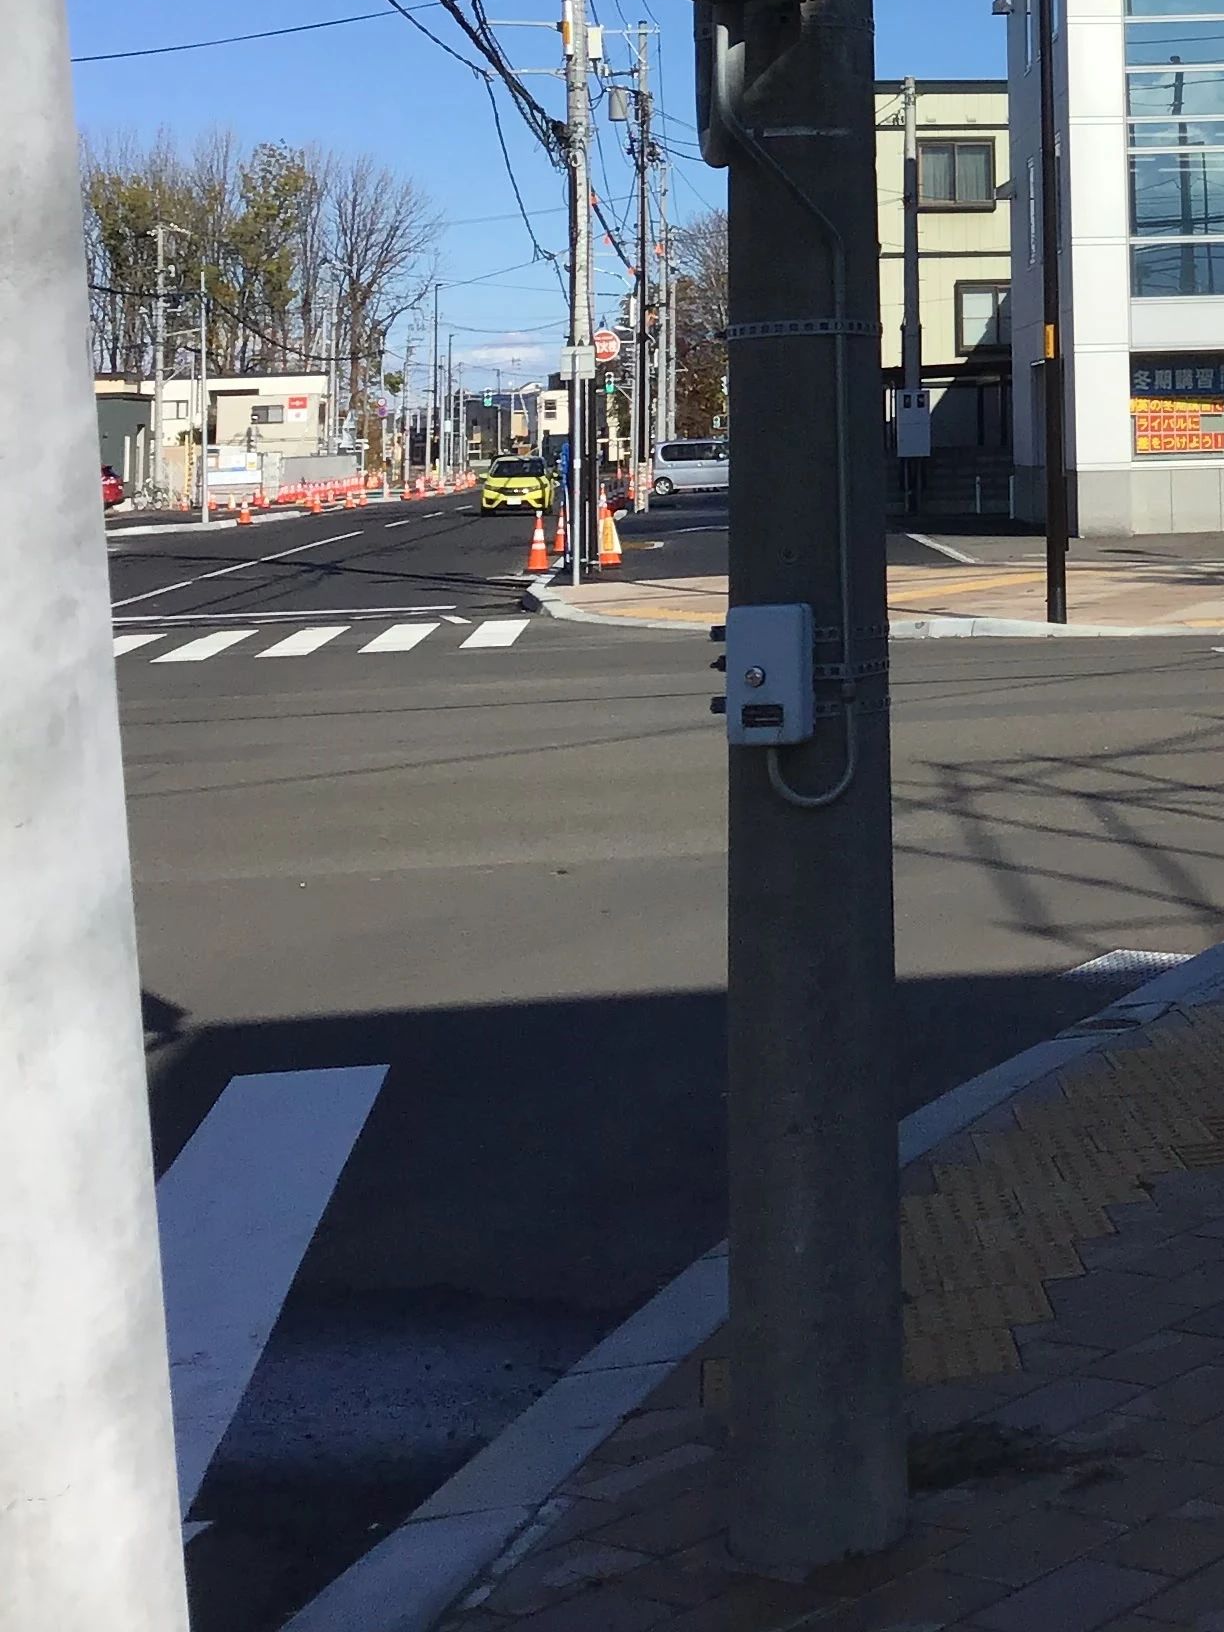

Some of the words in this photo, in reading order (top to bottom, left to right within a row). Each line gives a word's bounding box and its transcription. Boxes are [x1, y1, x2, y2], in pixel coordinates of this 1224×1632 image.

[1133, 368, 1214, 390] 冬期講習
[1138, 417, 1200, 431] ライバルに
